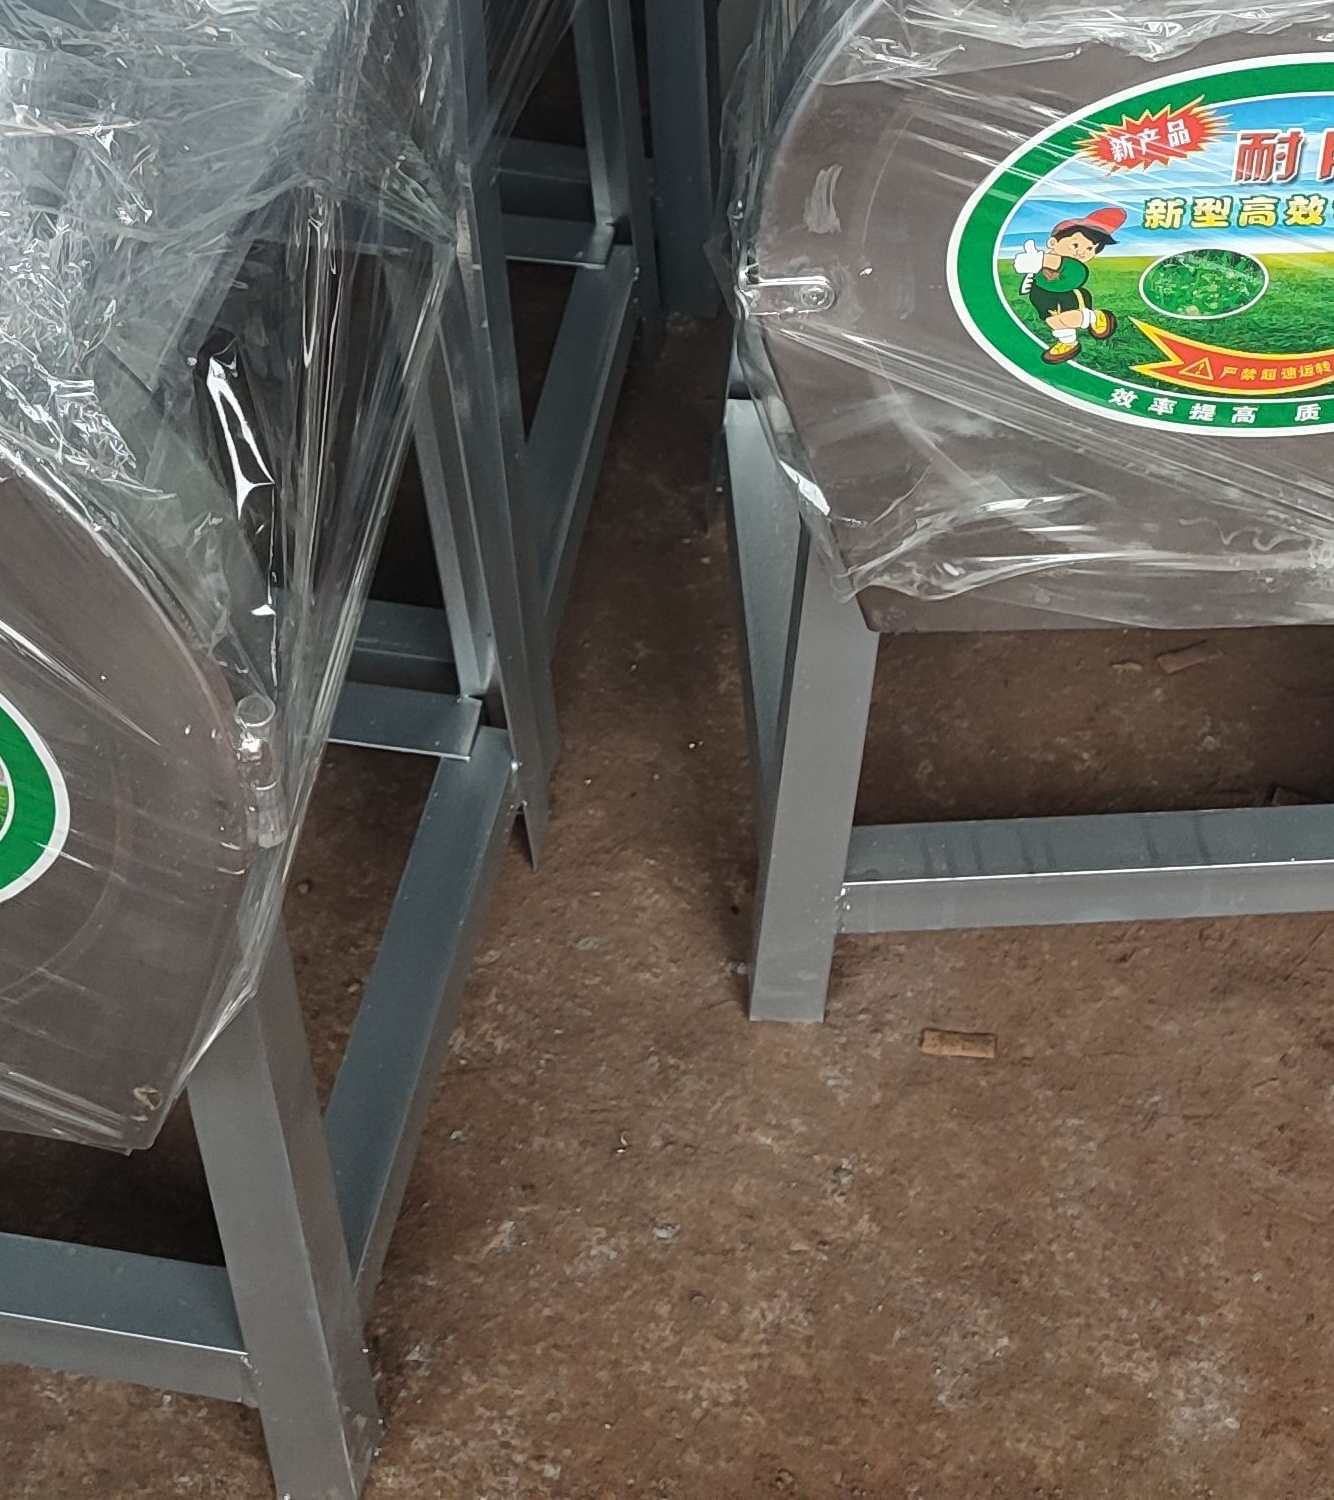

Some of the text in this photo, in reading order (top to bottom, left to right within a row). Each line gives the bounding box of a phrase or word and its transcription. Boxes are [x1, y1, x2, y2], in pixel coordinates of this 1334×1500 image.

[1109, 118, 1192, 162] 新产品
[1109, 387, 1259, 424] 效率提高
